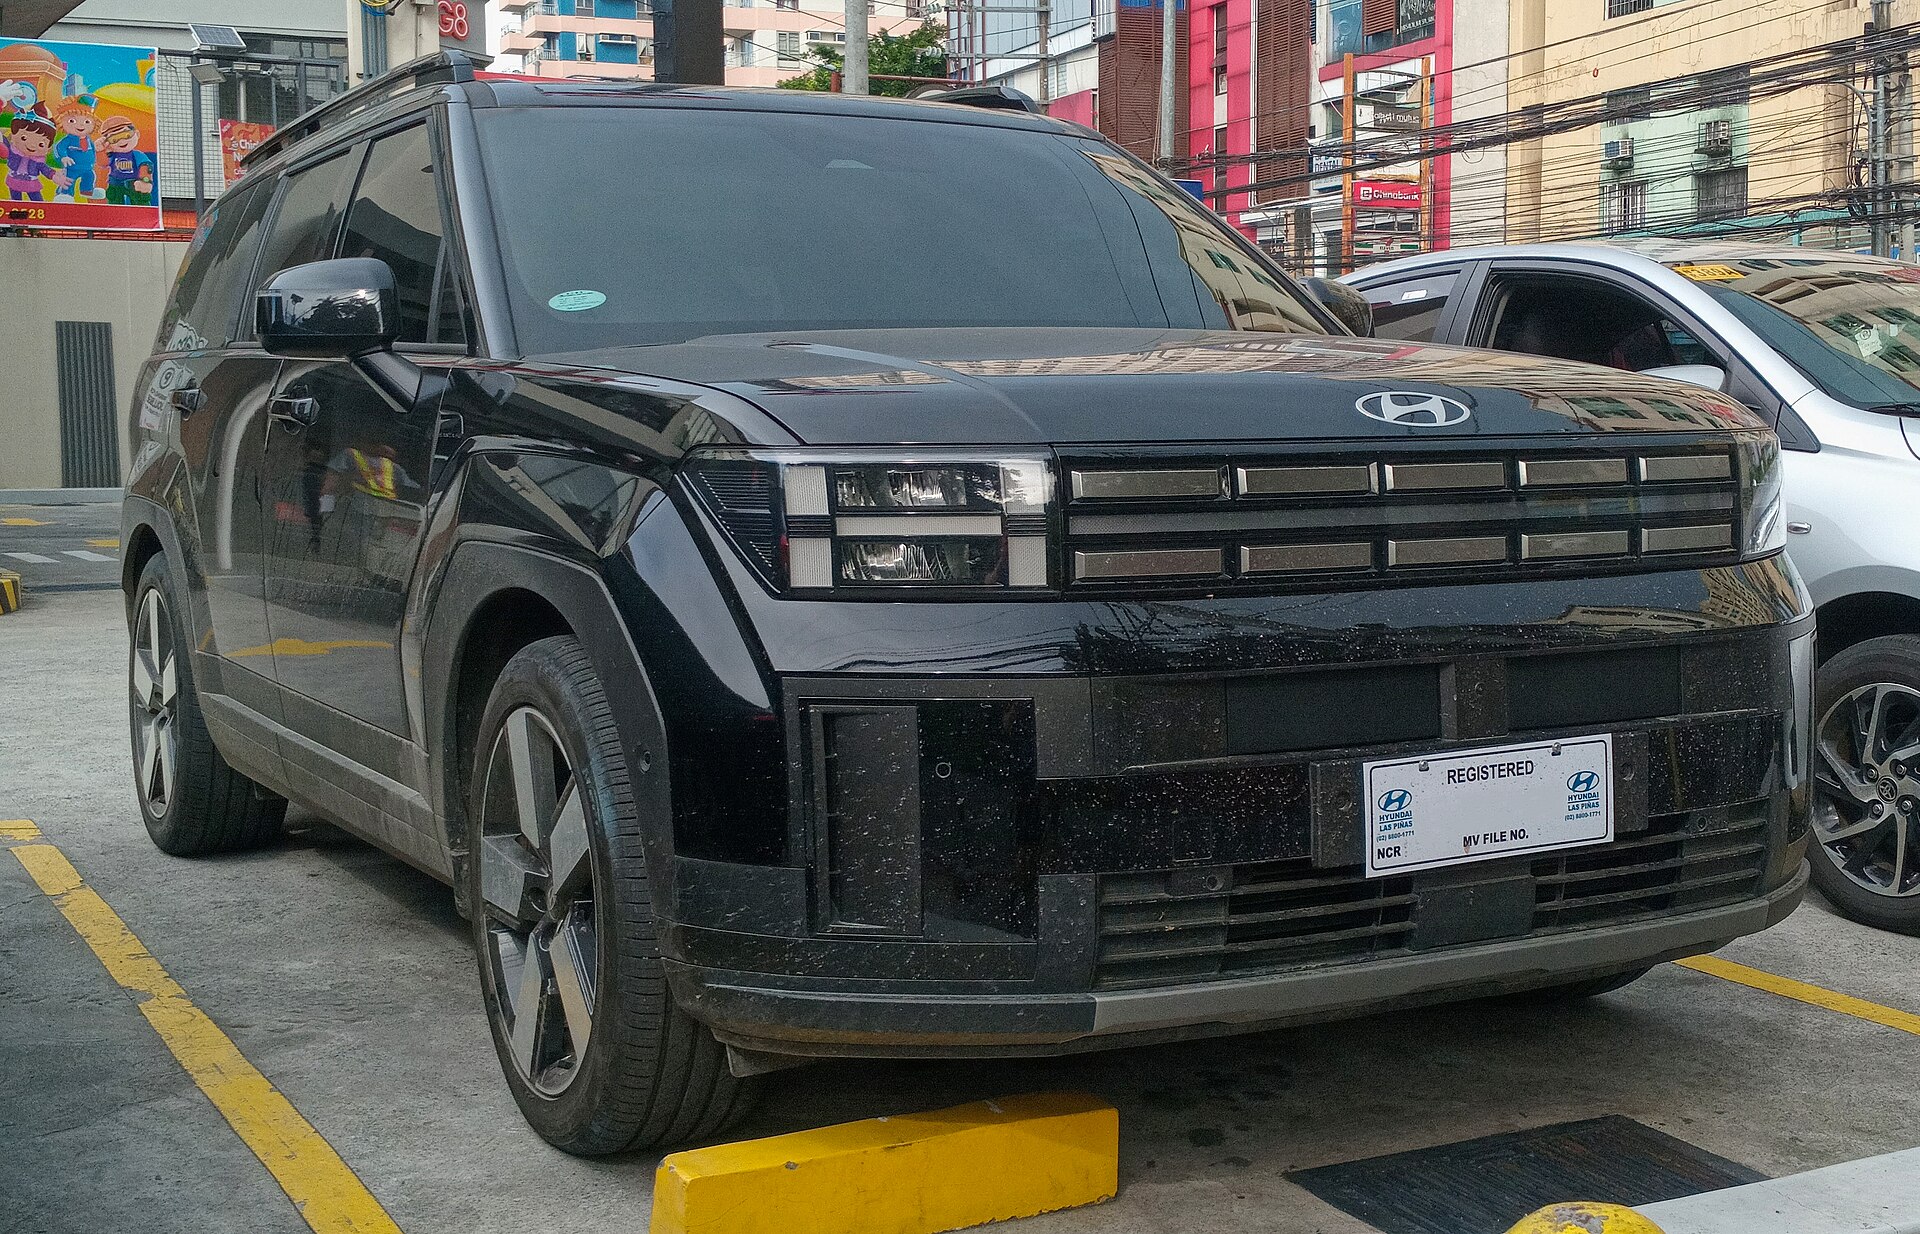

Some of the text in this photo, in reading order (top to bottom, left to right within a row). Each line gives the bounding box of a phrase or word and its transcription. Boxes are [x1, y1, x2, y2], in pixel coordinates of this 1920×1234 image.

[1447, 760, 1534, 785] REGISTERED
[1568, 791, 1599, 802] HYUNDAI
[1568, 801, 1600, 811] LAS PIÑAS
[1379, 810, 1412, 822] HYUNDAI
[1379, 820, 1413, 832] LAS PIÑAS
[1463, 828, 1529, 848] MV FILE NO.
[1377, 845, 1401, 860] NCR
